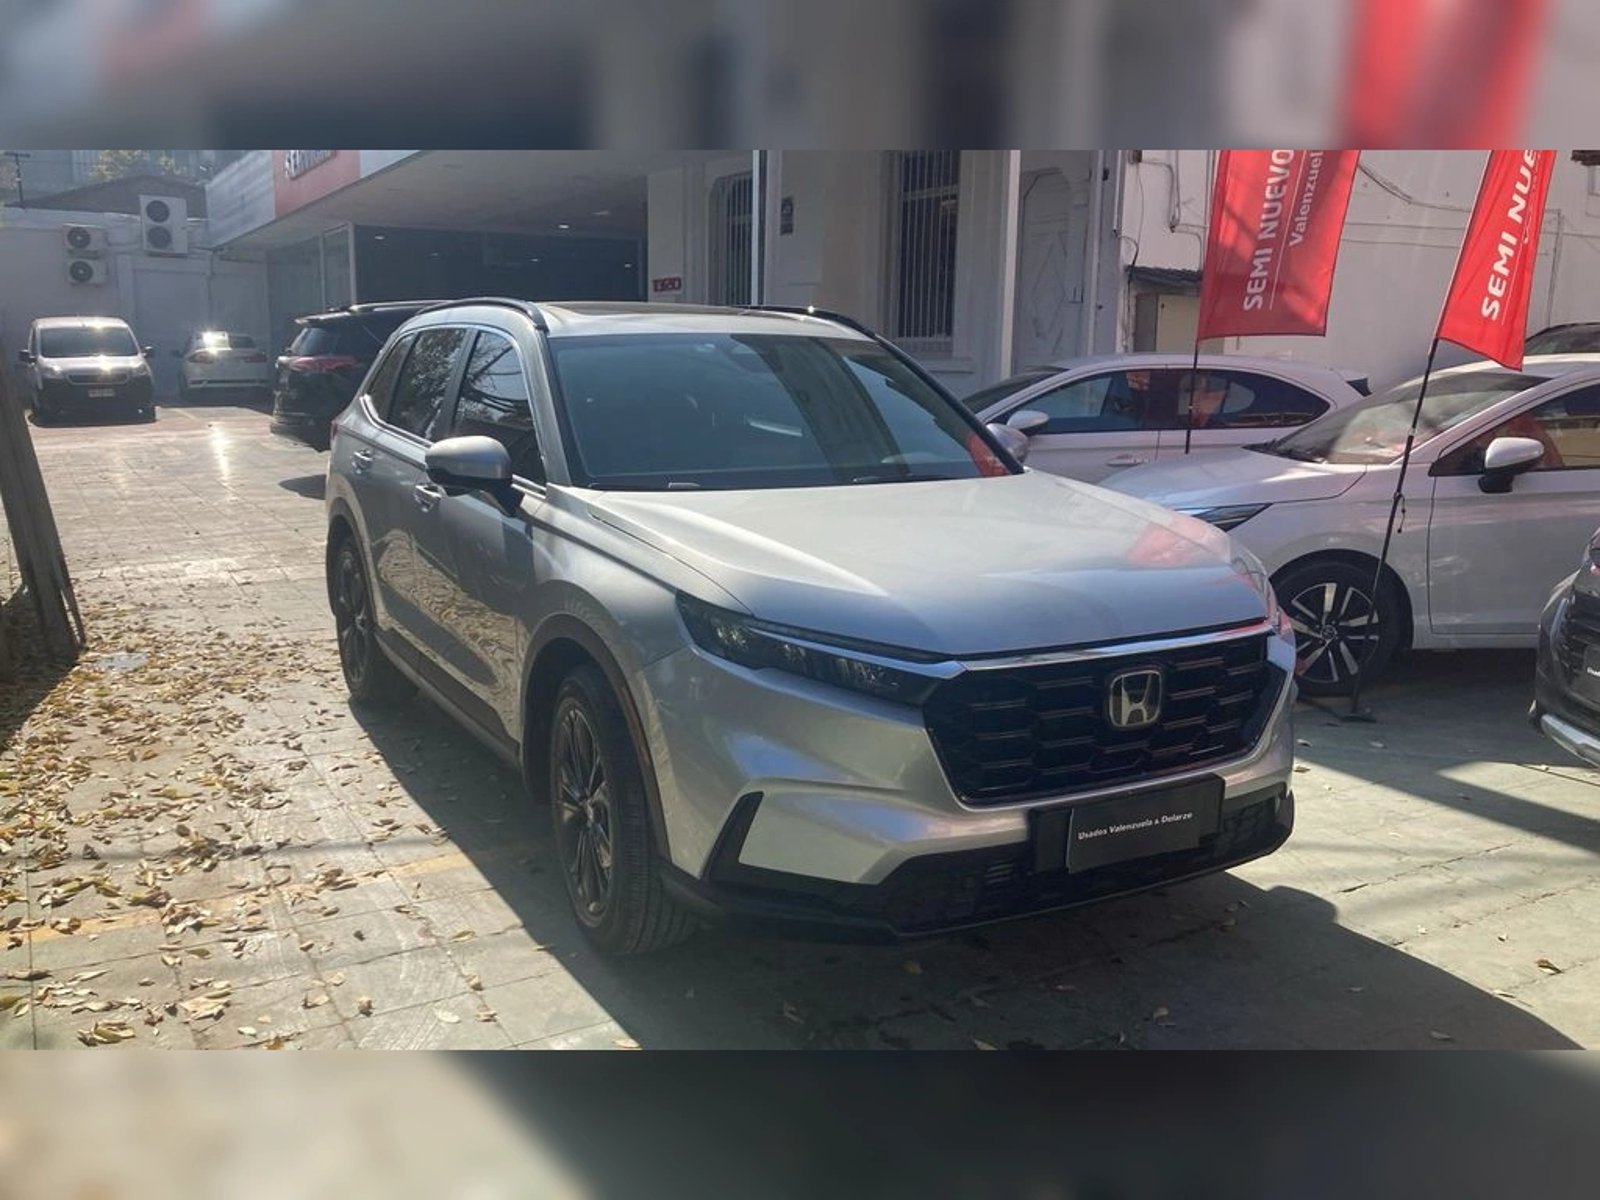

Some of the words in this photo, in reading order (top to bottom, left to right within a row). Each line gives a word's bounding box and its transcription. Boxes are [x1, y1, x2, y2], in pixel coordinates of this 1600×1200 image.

[1243, 248, 1273, 311] SEMI
[1481, 231, 1518, 321] SEMI
[1078, 823, 1108, 841] Usados
